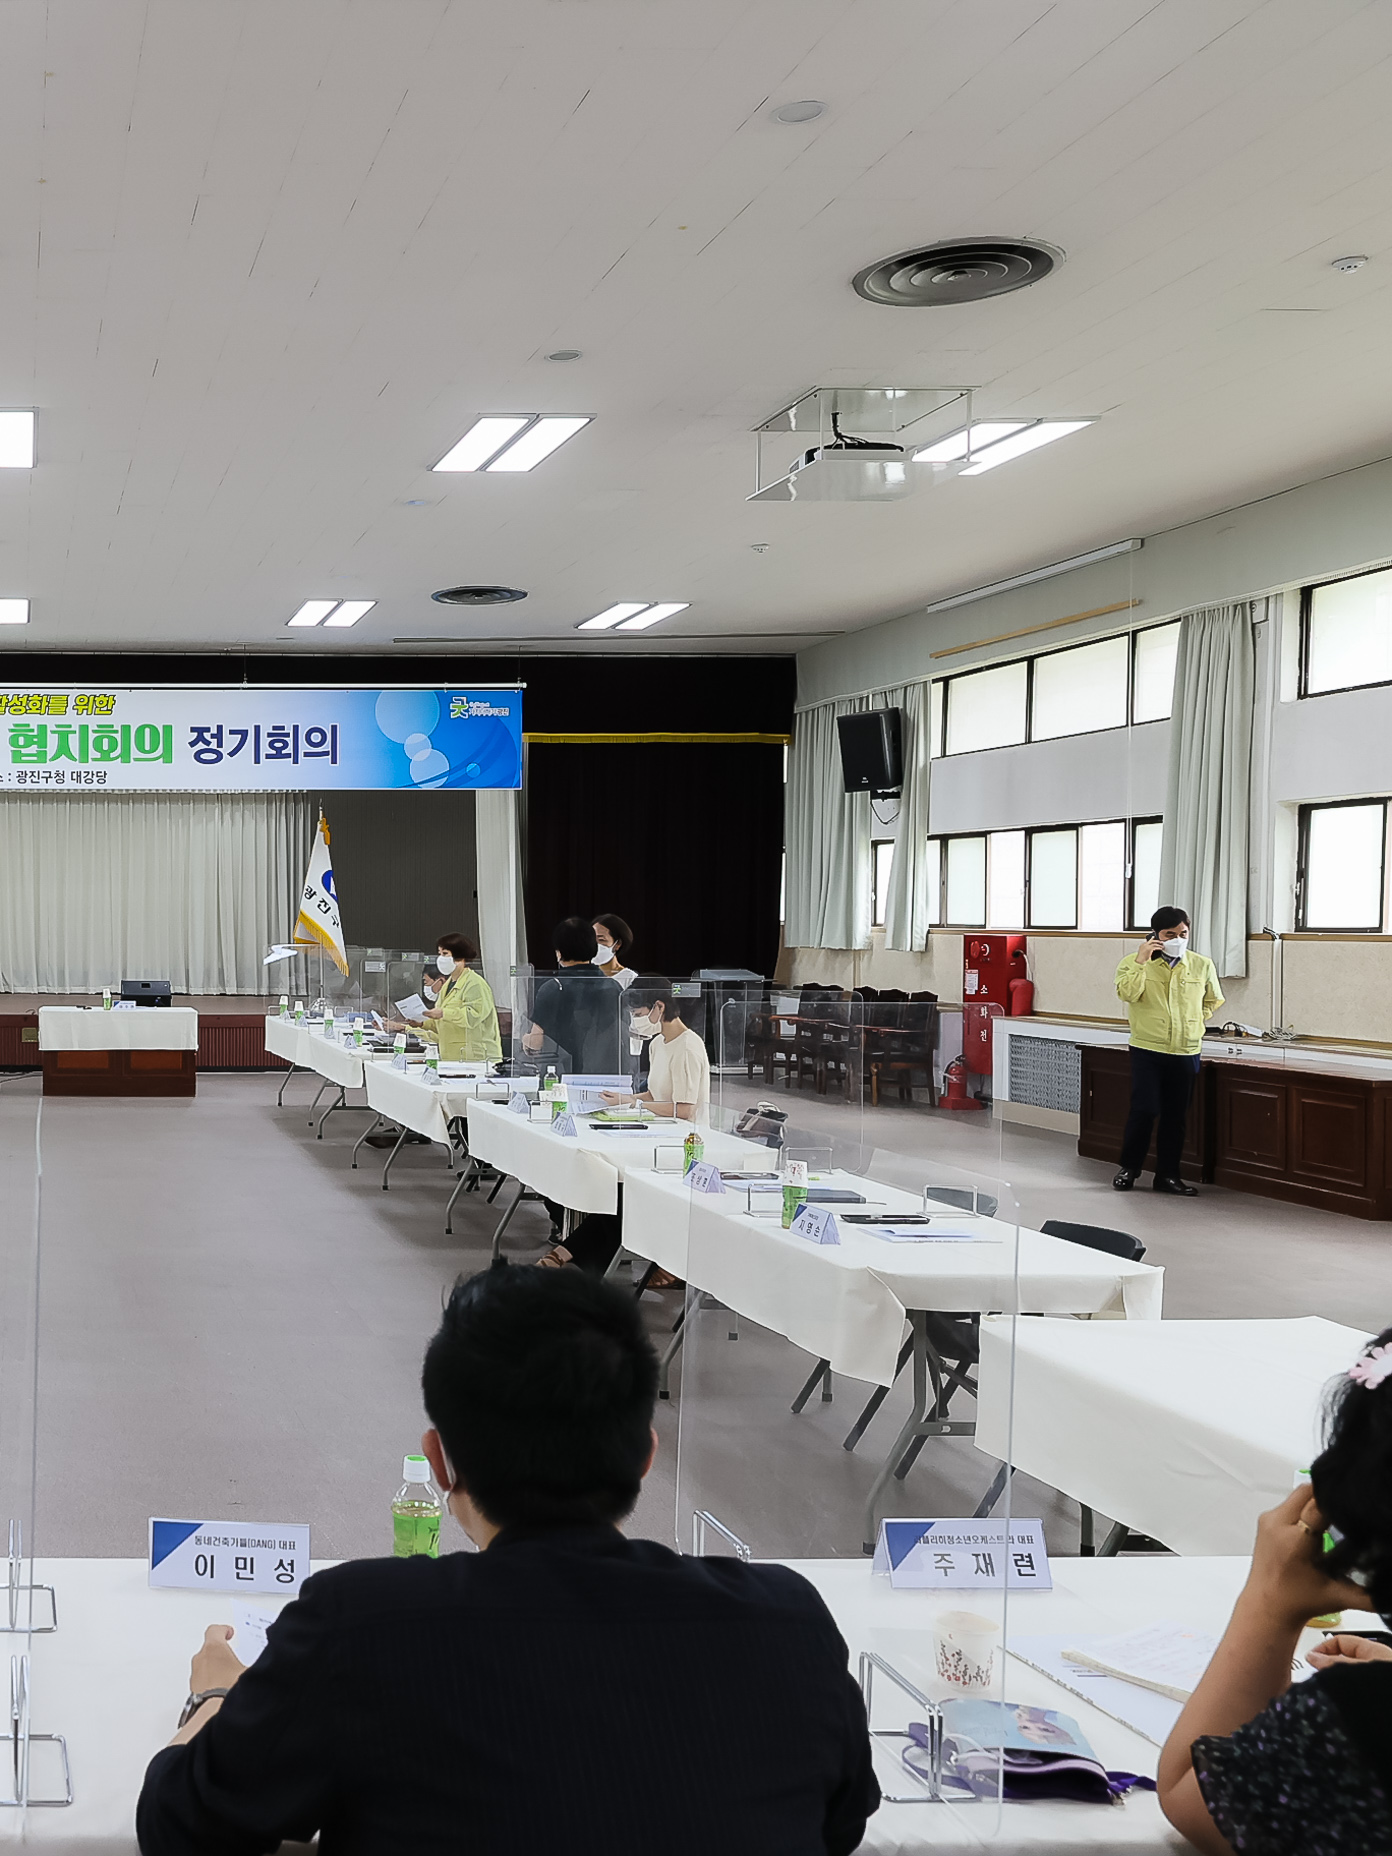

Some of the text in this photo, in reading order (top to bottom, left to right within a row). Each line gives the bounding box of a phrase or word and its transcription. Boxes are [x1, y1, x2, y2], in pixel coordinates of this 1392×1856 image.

[72, 694, 116, 715] 위한
[8, 724, 173, 765] 협치회의
[187, 724, 339, 765] 정기회의
[16, 770, 65, 784] 광진구청
[70, 770, 108, 784] 대강당
[279, 1539, 296, 1551] 대표
[1017, 1534, 1035, 1545] 대표
